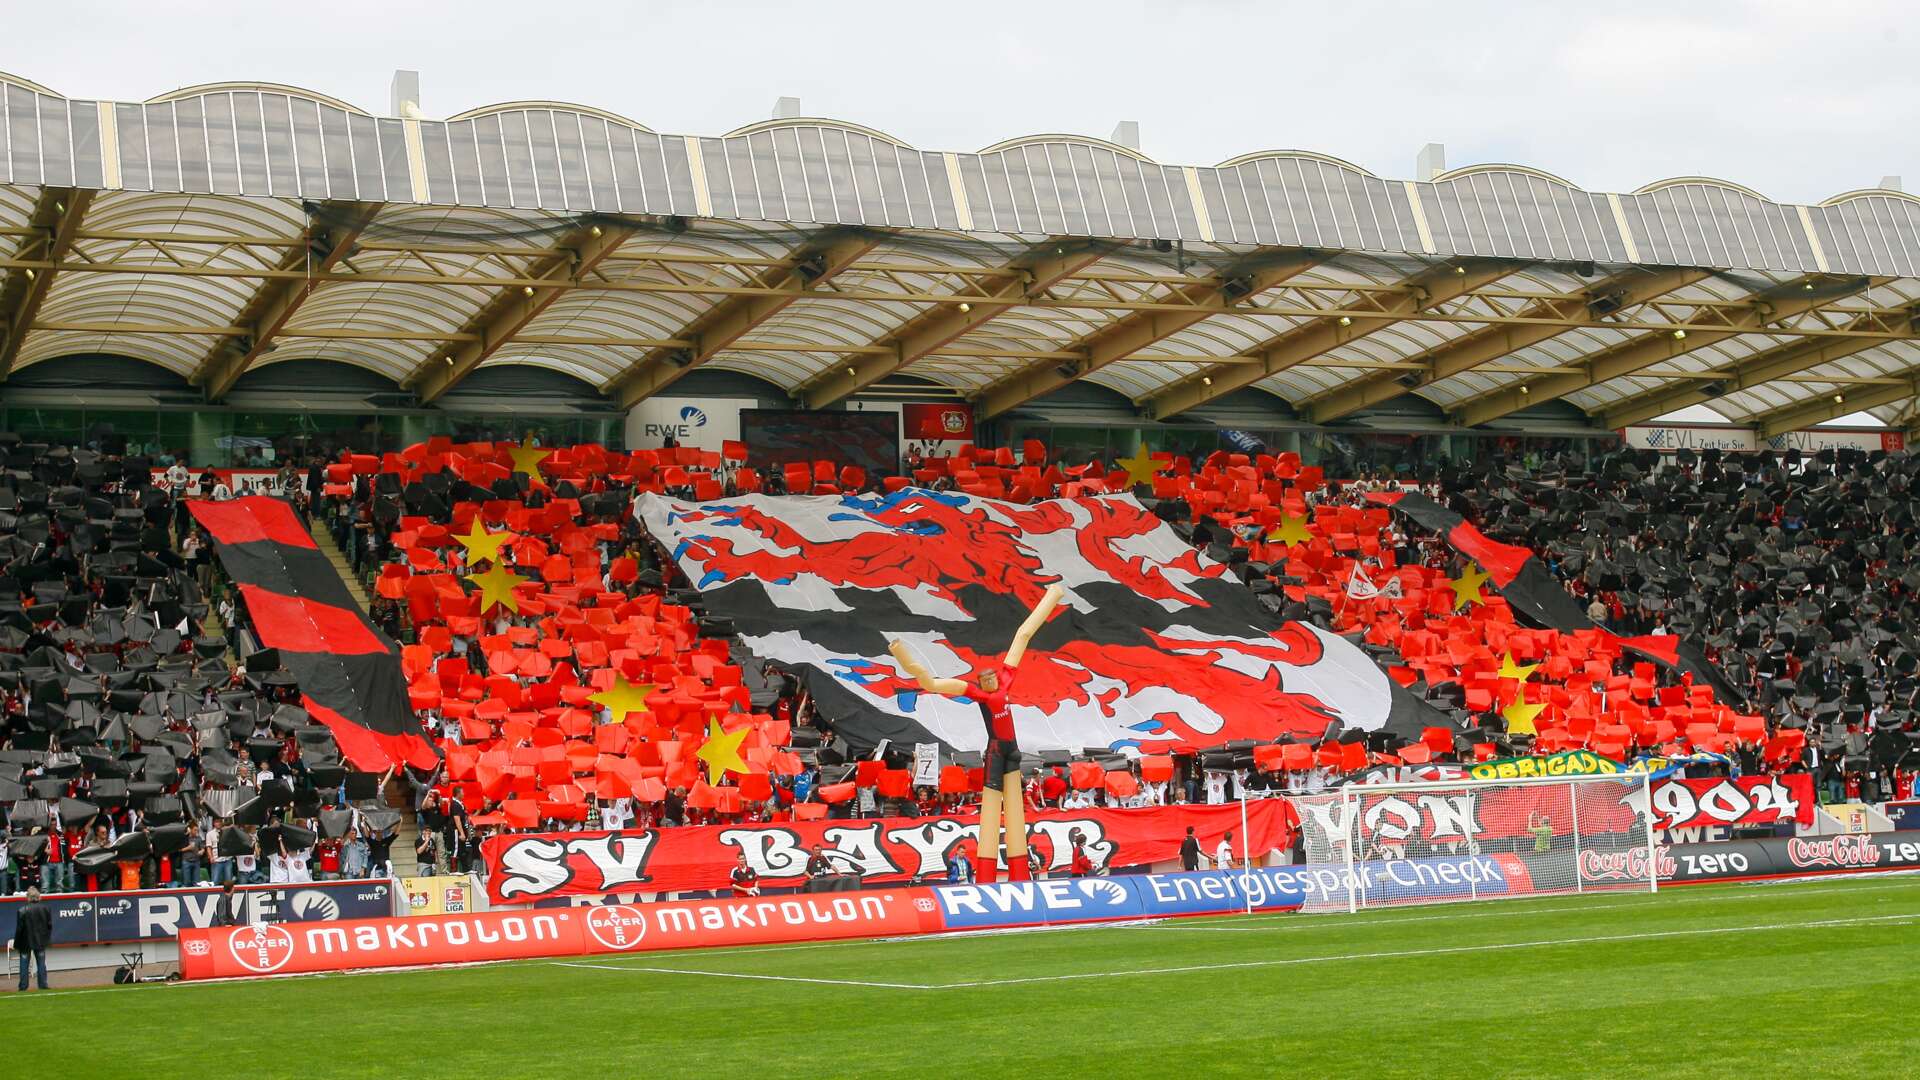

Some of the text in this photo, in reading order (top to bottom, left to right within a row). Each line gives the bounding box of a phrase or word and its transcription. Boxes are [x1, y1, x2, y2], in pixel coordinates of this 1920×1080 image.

[645, 424, 690, 437] RWE
[1666, 429, 1697, 449] EVL
[920, 760, 932, 775] 7
[1472, 753, 1616, 780] OBRIGADO
[500, 829, 656, 899] SV
[1303, 795, 1483, 848] VON
[1619, 776, 1799, 828] 1904
[1682, 851, 1748, 875] zero
[1146, 857, 1503, 906] Energiespar-Check
[357, 893, 381, 902] RWE
[936, 880, 1082, 915] RWE
[59, 908, 84, 918] RWE
[99, 906, 123, 916] RWE
[139, 890, 286, 937] RWE
[592, 917, 641, 928] BAYER
[235, 938, 288, 949] BAYER
